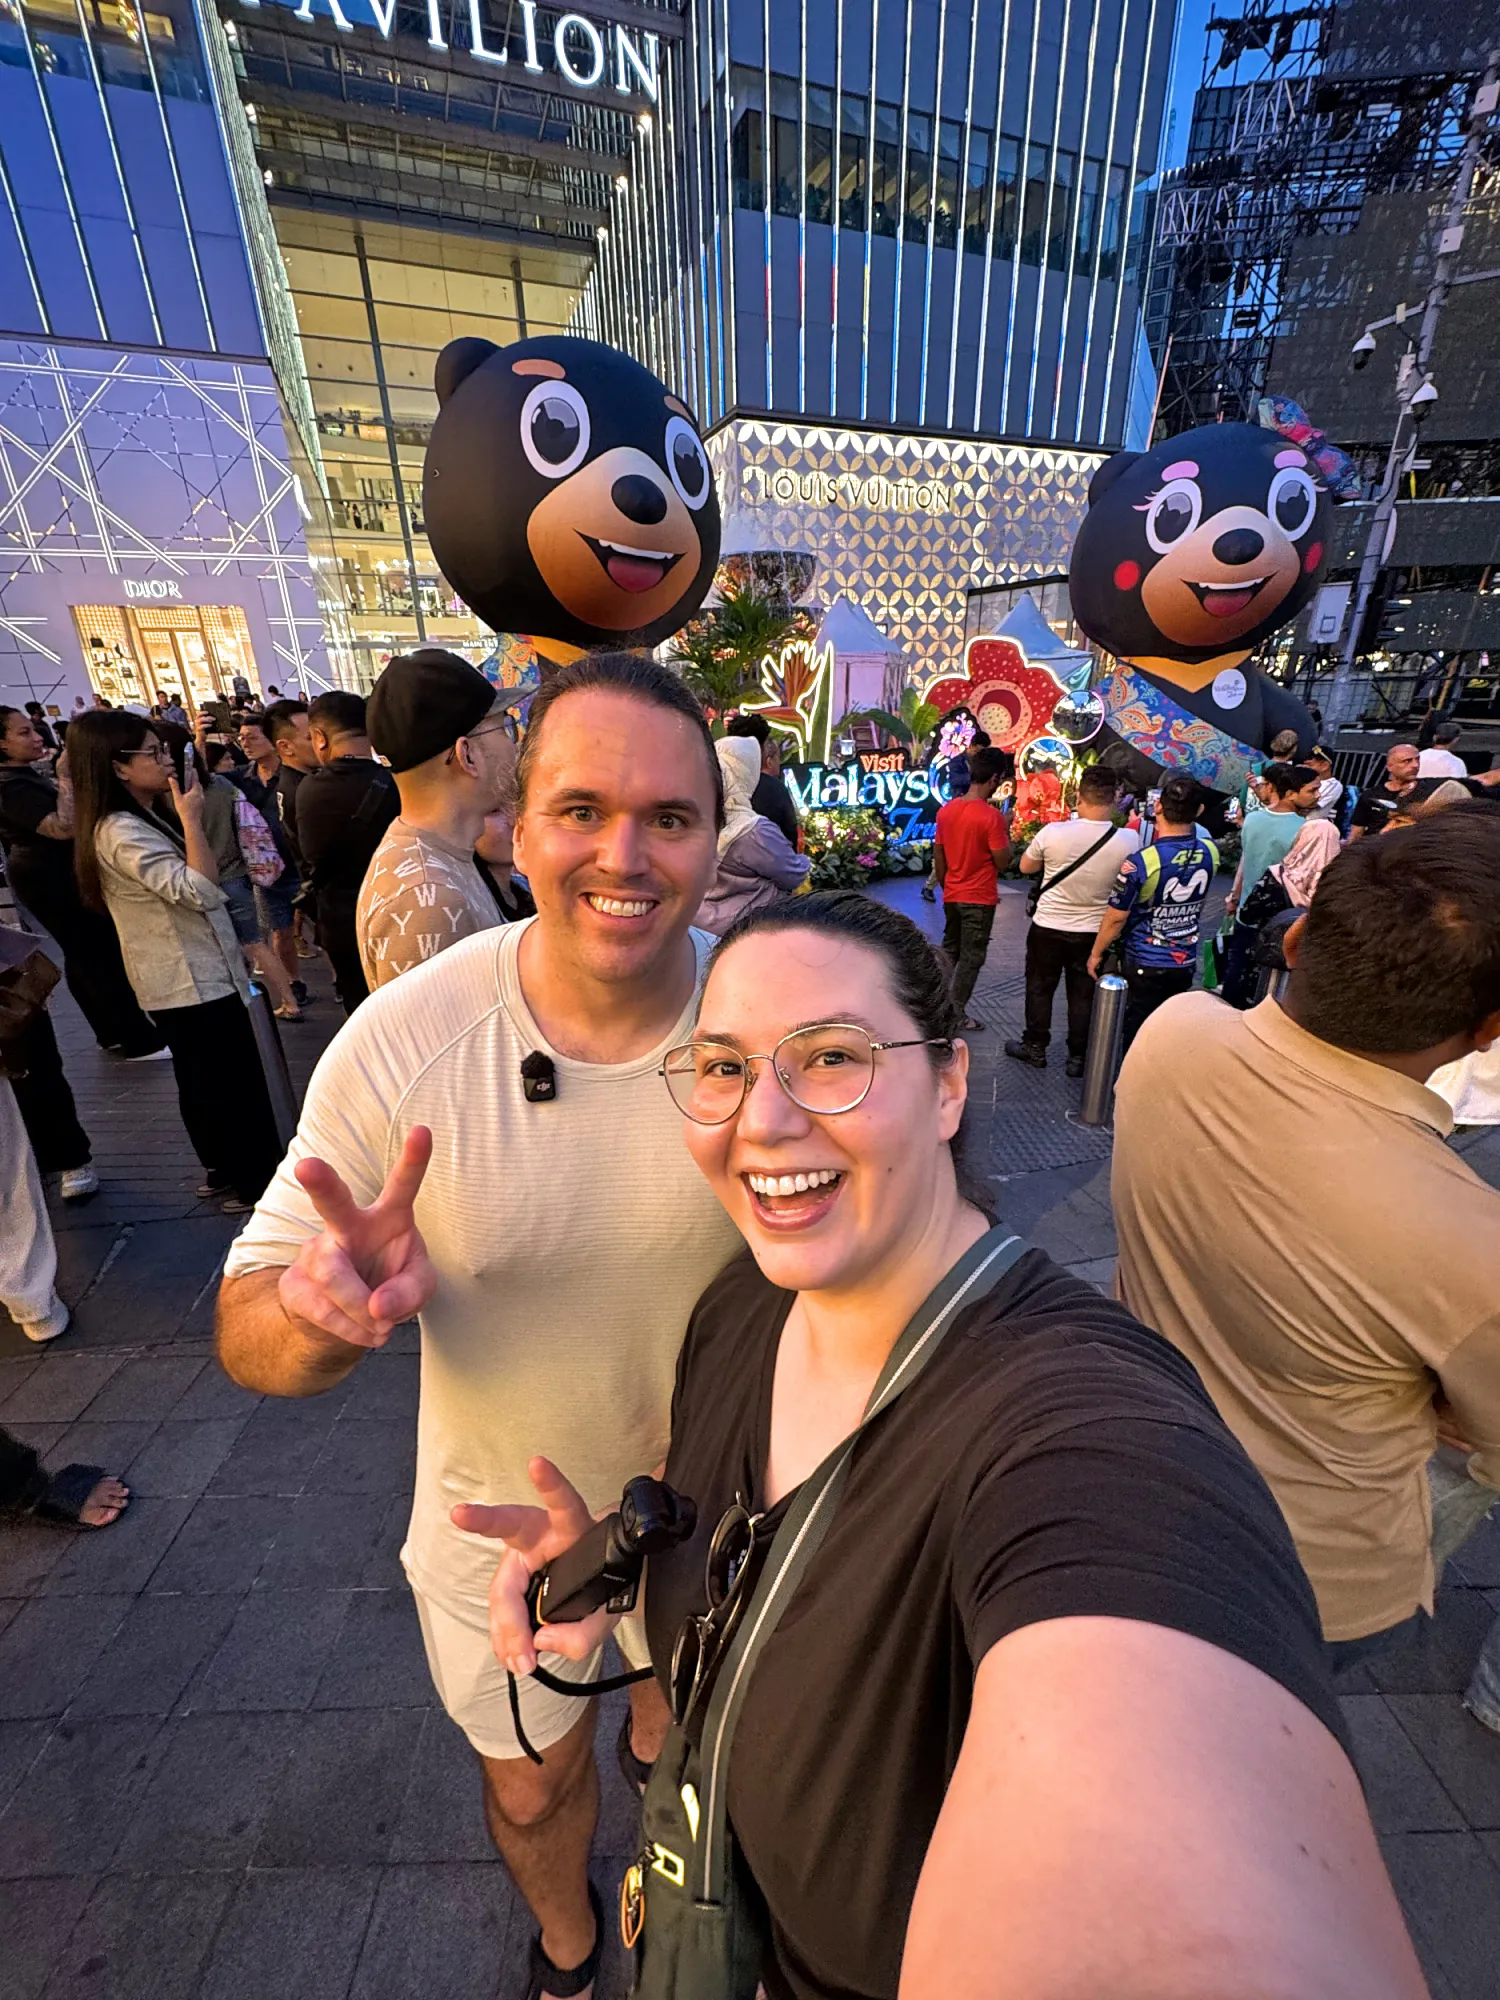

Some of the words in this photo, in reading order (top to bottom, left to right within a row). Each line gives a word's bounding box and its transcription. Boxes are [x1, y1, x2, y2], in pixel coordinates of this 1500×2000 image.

[238, 0, 659, 99] VILION
[764, 475, 838, 503] LOUIS
[848, 479, 951, 509] VUITTON
[124, 580, 183, 599] DIOR
[860, 753, 905, 773] Visit
[888, 807, 937, 846] Tru
[389, 910, 413, 936] Y
[442, 907, 464, 933] Y
